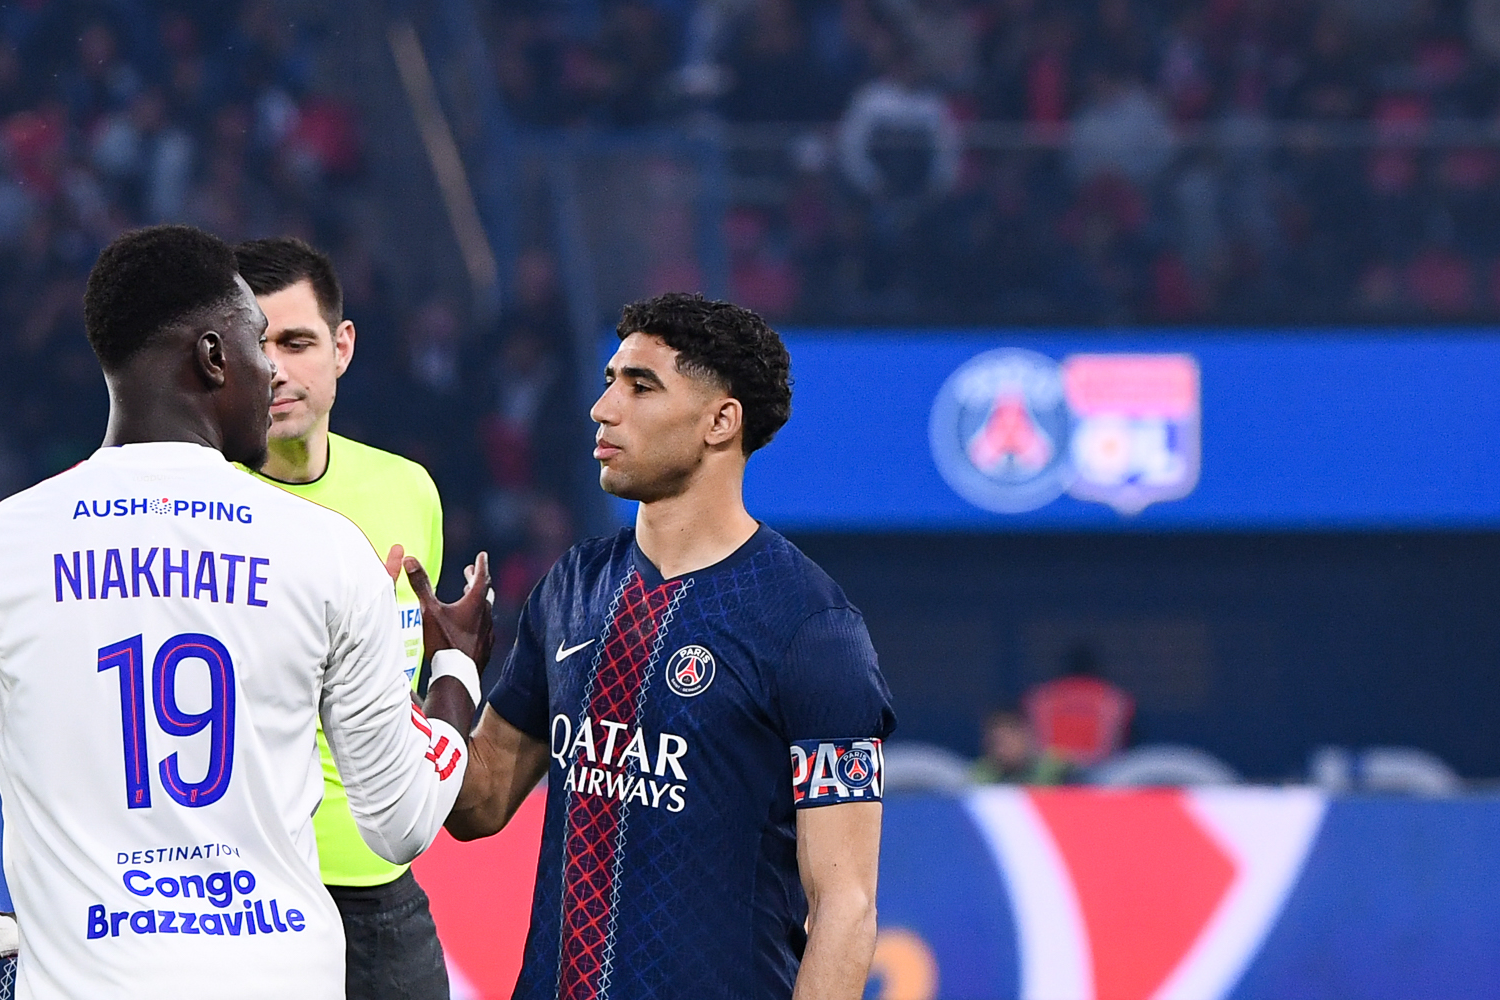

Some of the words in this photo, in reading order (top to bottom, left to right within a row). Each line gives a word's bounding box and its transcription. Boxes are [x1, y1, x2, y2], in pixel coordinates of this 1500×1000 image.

[53, 546, 270, 608] NIAKHATE
[400, 608, 421, 630] IFA
[680, 648, 711, 664] PARIS
[97, 632, 236, 809] 19
[551, 713, 688, 781] QATAR
[843, 751, 867, 762] PARIS
[563, 765, 686, 813] AIRWAYS
[122, 869, 256, 908] Congo
[86, 898, 306, 940] Brazzaville
